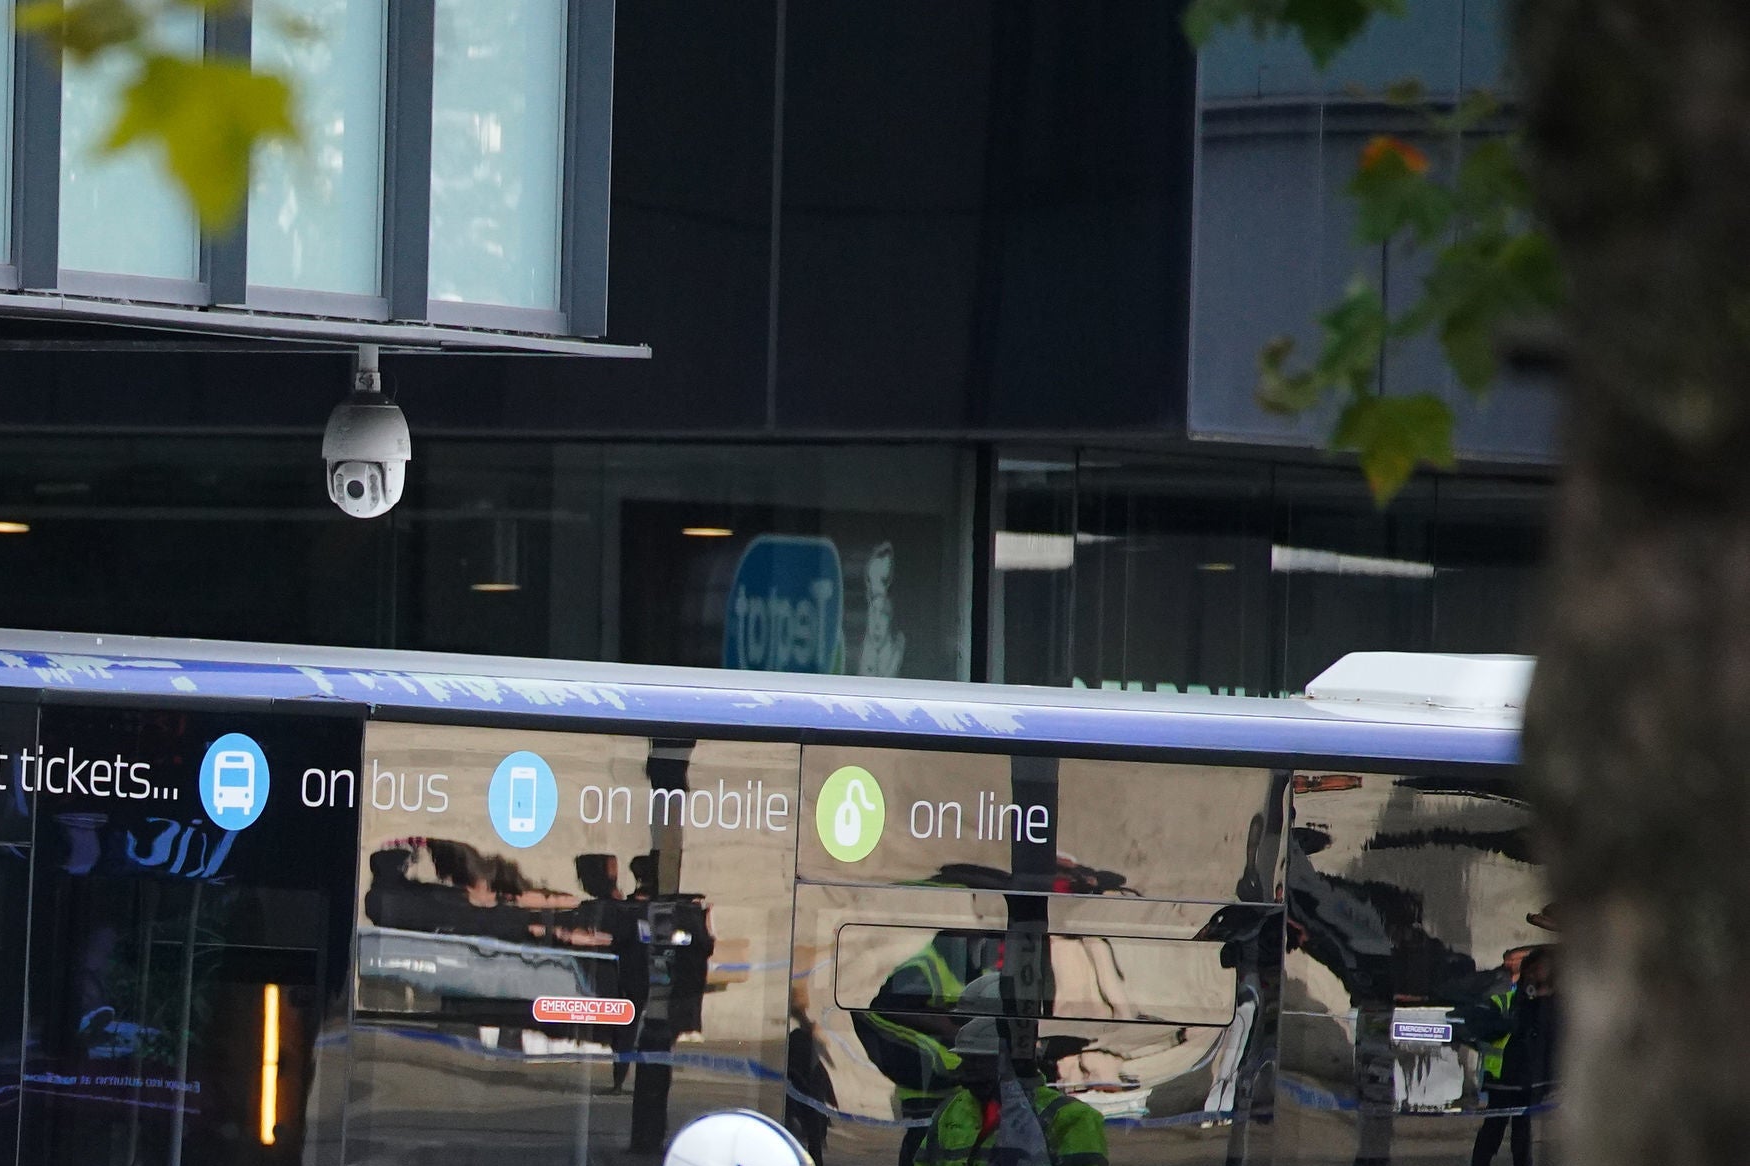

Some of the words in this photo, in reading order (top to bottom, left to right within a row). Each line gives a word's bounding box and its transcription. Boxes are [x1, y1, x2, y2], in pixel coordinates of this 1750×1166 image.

[20, 744, 179, 802] tickets...
[301, 768, 355, 808] on
[371, 760, 450, 812] bus
[579, 782, 631, 825] on
[647, 778, 789, 833] mobile
[909, 797, 962, 840] on
[978, 789, 1049, 845] line
[540, 999, 604, 1013] EMERGENCY
[604, 1002, 627, 1014] EXIT
[1399, 1025, 1433, 1033] EMERGENCY
